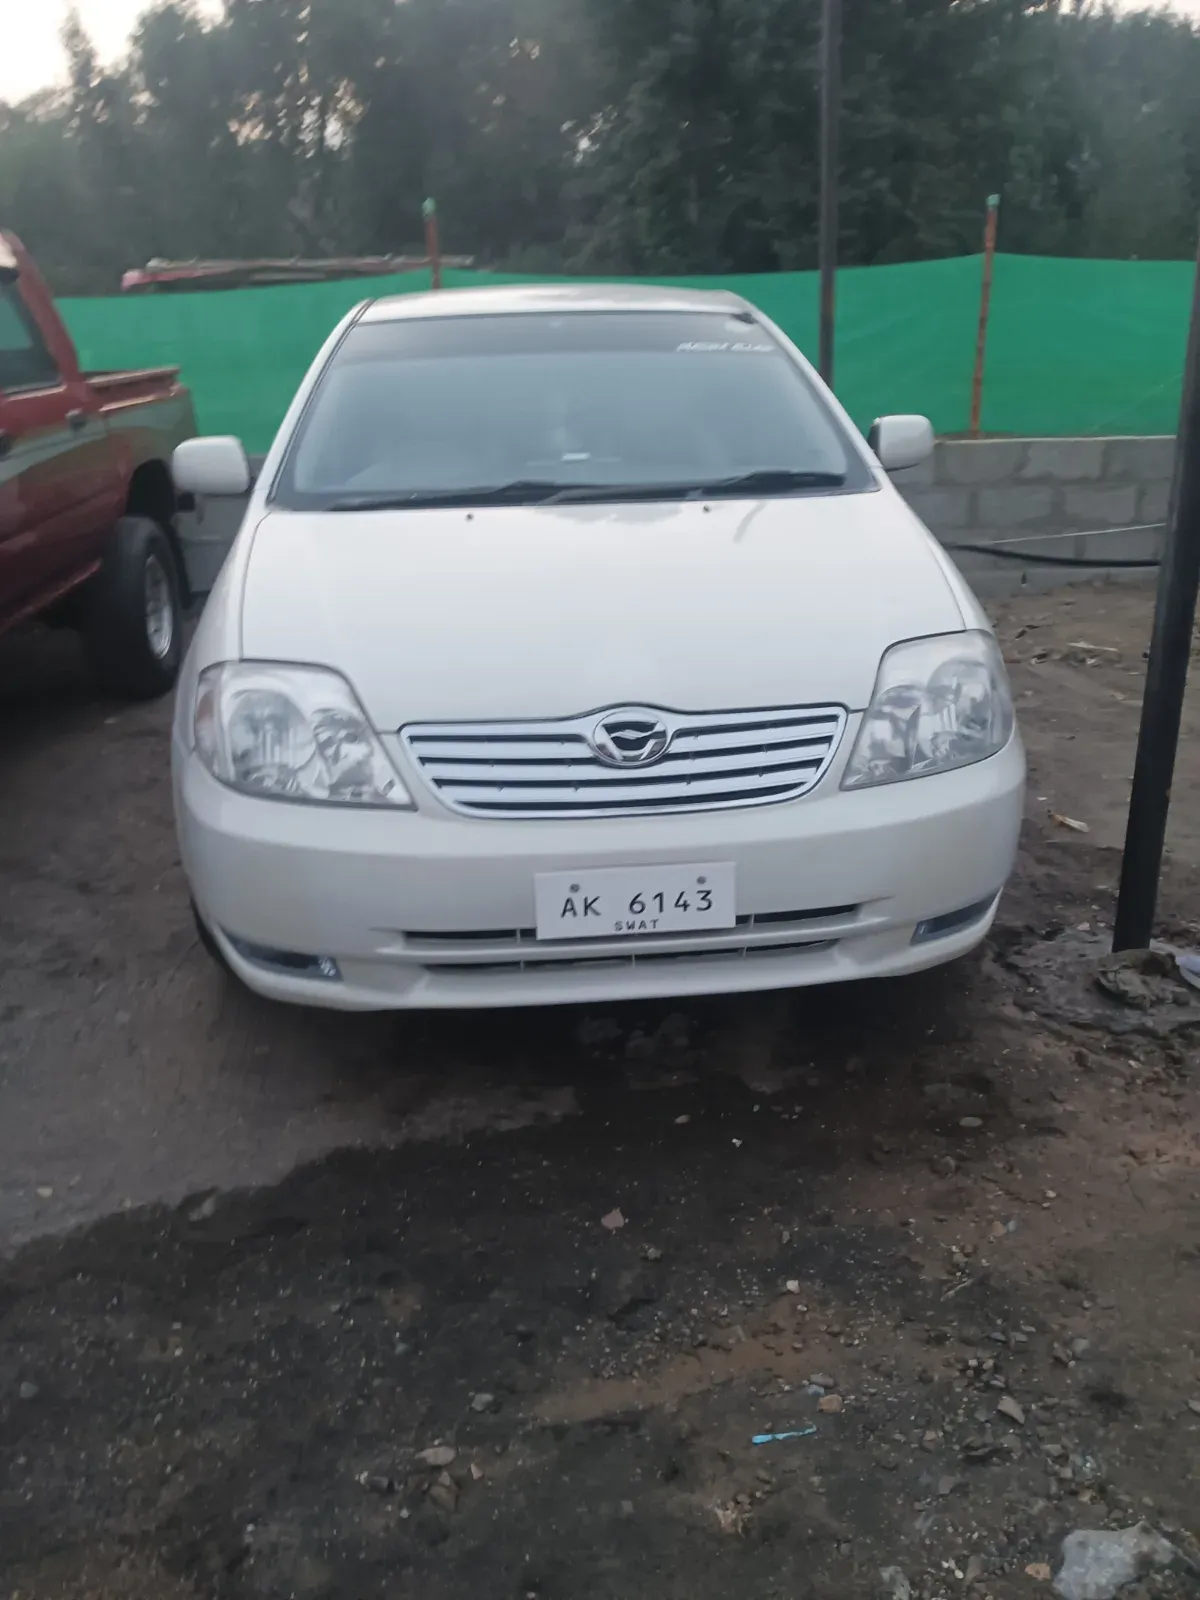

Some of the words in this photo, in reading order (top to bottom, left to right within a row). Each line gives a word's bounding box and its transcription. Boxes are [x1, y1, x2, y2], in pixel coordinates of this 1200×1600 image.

[561, 896, 601, 918] AK
[628, 889, 713, 915] 6143
[614, 919, 660, 931] SWAT
